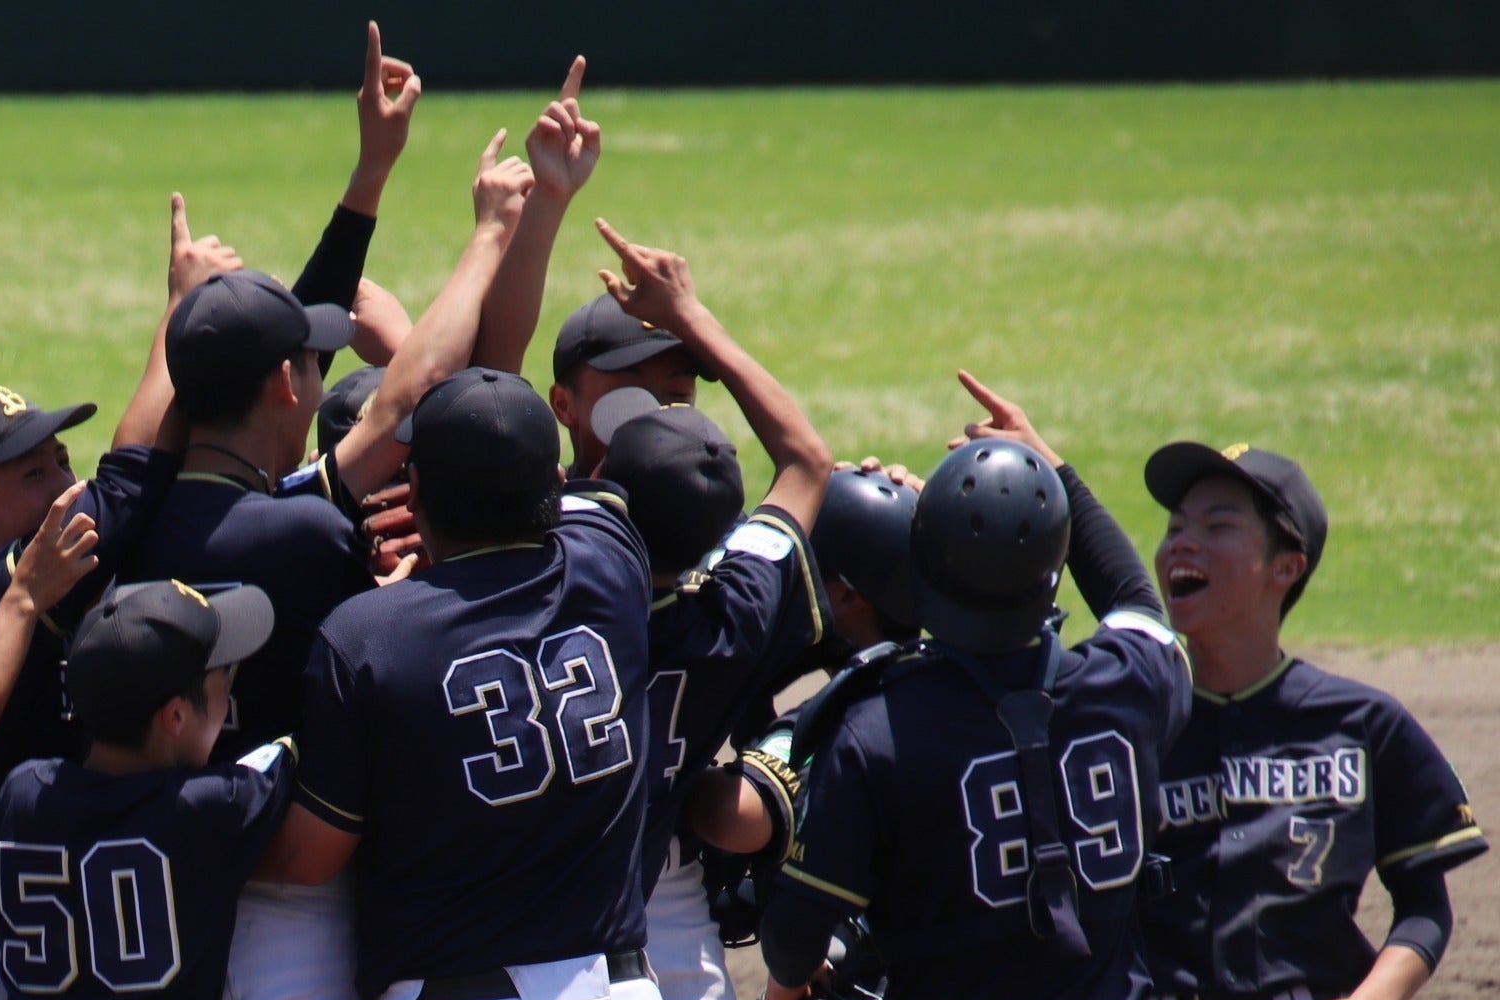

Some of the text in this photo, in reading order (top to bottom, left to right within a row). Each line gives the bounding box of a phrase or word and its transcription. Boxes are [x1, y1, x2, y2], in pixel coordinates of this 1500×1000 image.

[443, 624, 632, 806] 32
[960, 730, 1145, 907] 89
[1158, 747, 1367, 828] CCANEERS
[1287, 815, 1335, 886] 7
